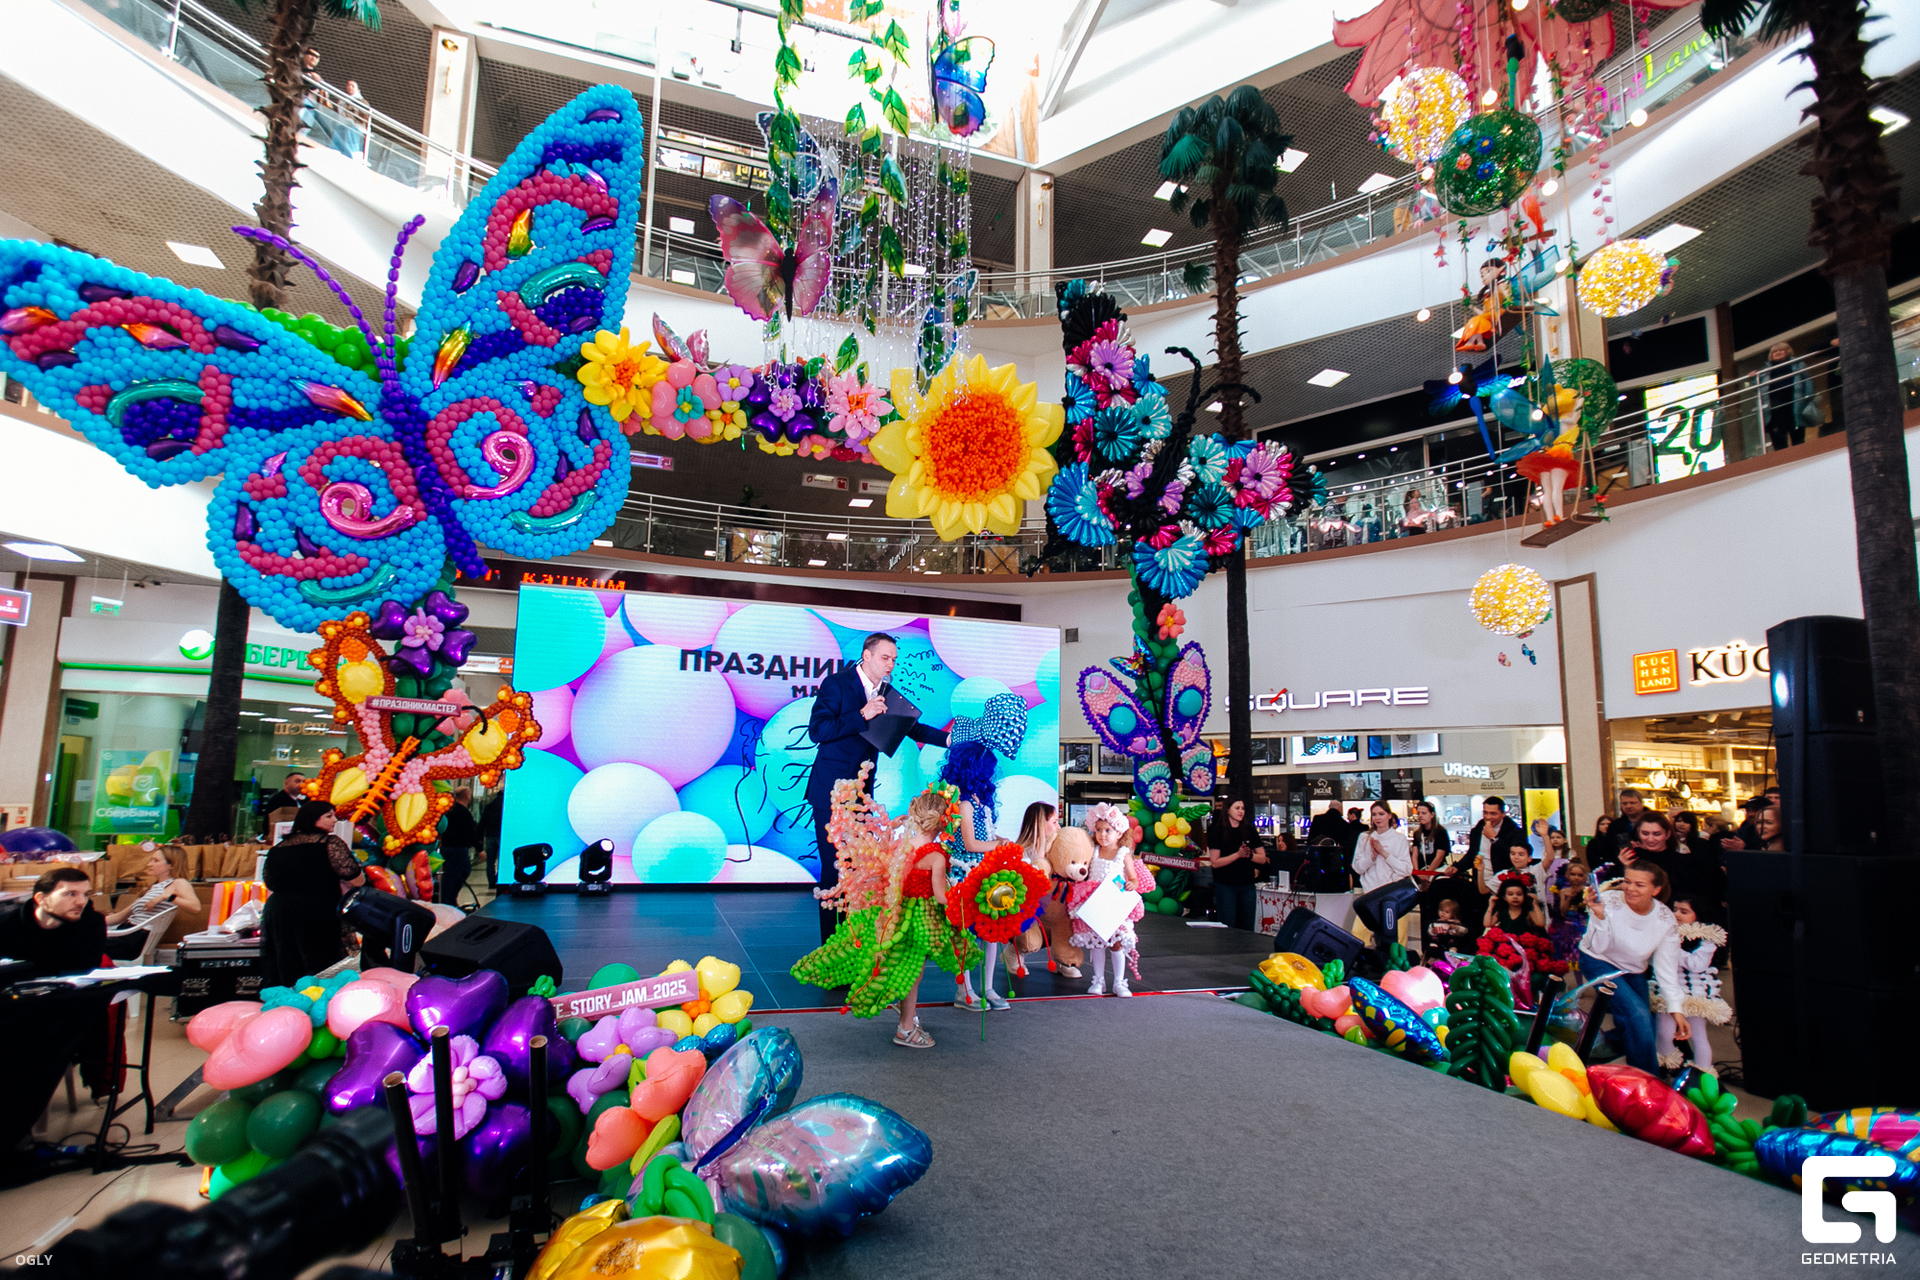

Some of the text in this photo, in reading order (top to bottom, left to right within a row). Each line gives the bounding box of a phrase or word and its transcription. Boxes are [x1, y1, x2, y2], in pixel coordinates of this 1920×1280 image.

[1641, 666, 1670, 678] HEN
[1641, 677, 1672, 688] LAND
[371, 698, 457, 713] #ПРАЗДНИКМАСТЕР
[553, 979, 687, 1020] E_STORY_JAM_2025
